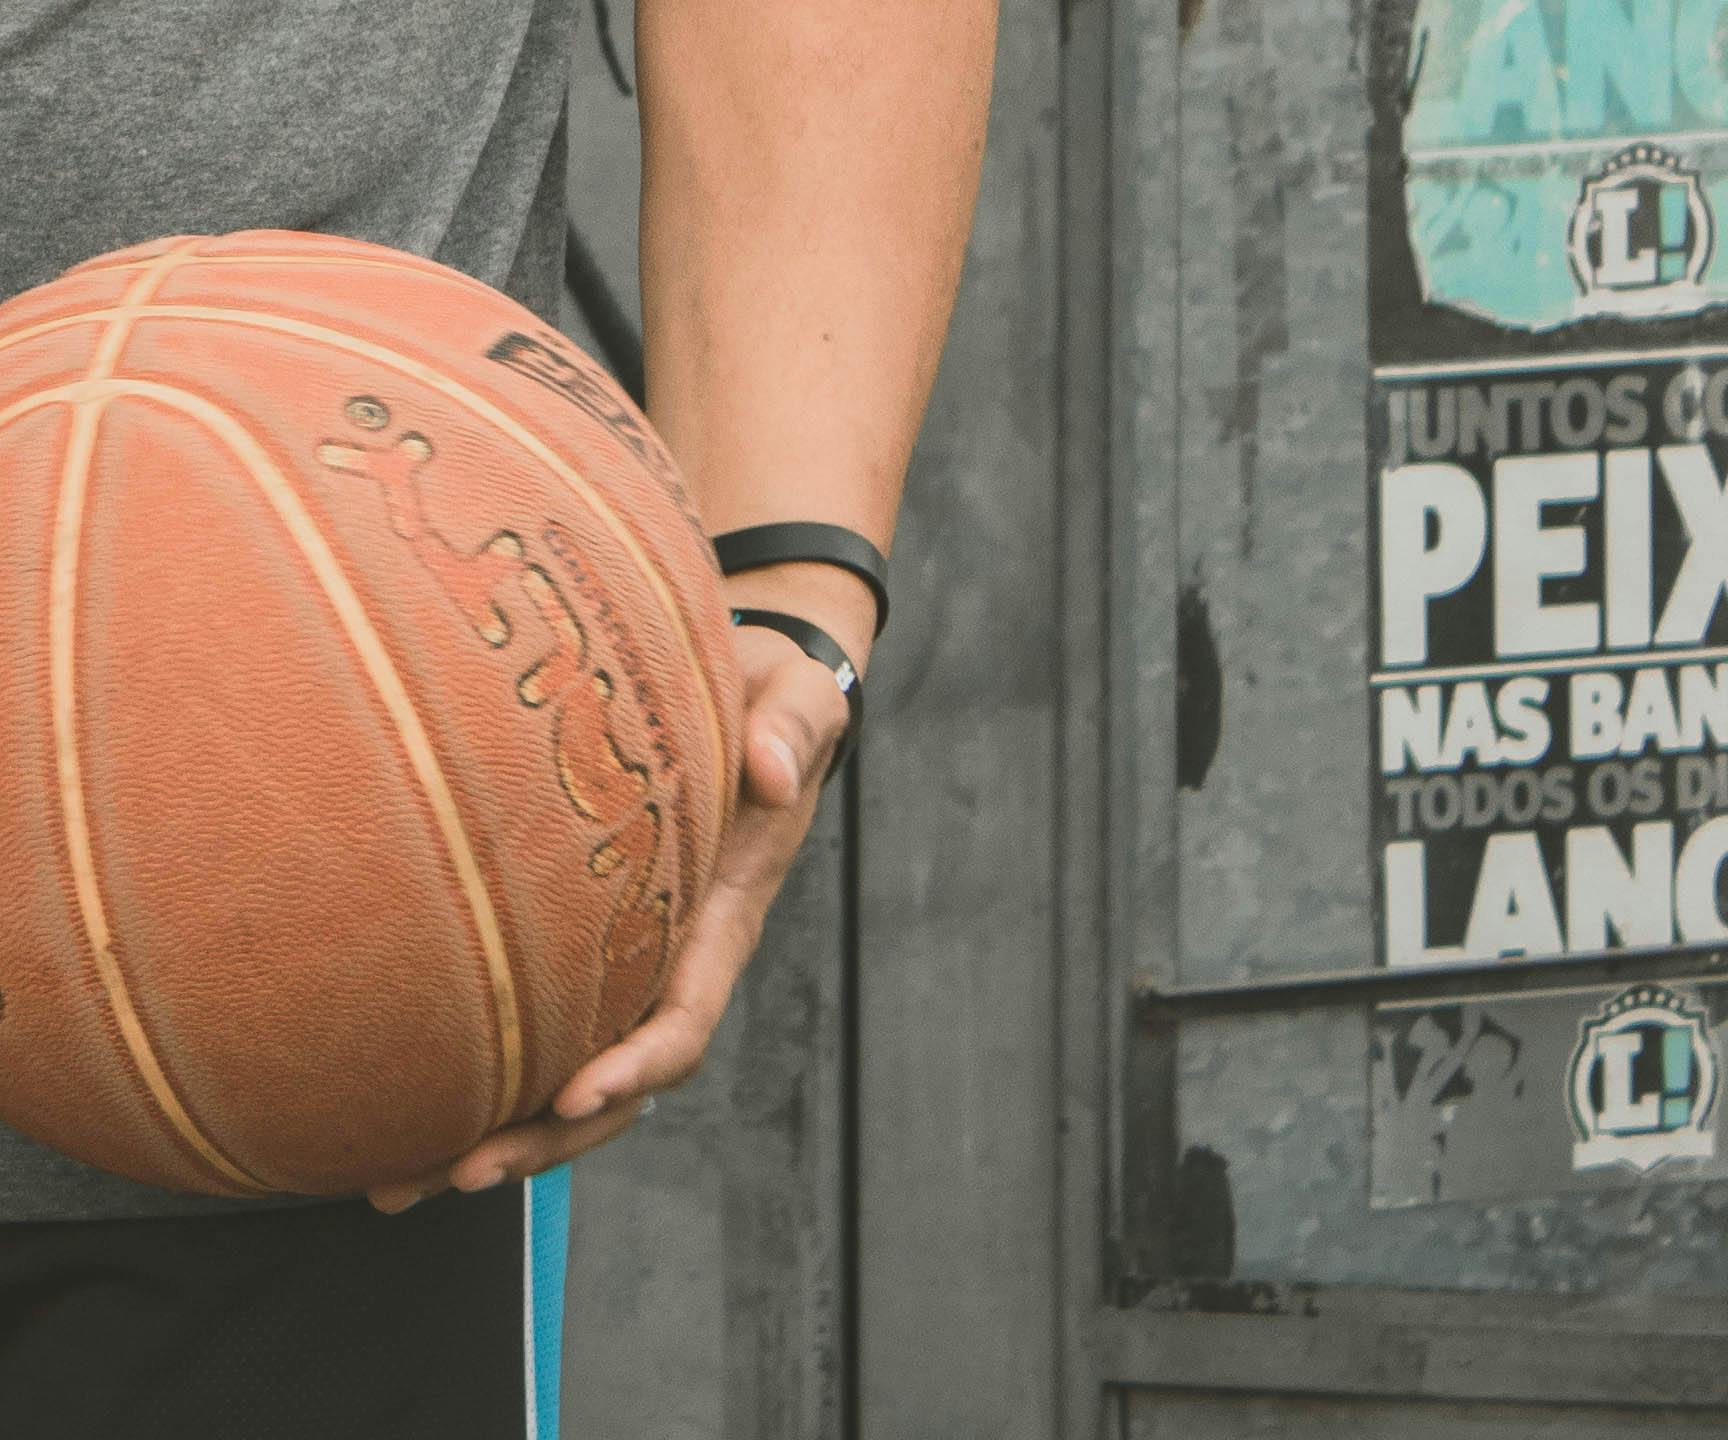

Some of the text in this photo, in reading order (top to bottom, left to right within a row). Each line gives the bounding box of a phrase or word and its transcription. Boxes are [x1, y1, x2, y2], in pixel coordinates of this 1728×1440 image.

[1383, 373, 1648, 472] JUNTOS
[1381, 676, 1552, 776] NAS
[1386, 765, 1575, 834] TODOS
[1587, 759, 1664, 817] OS
